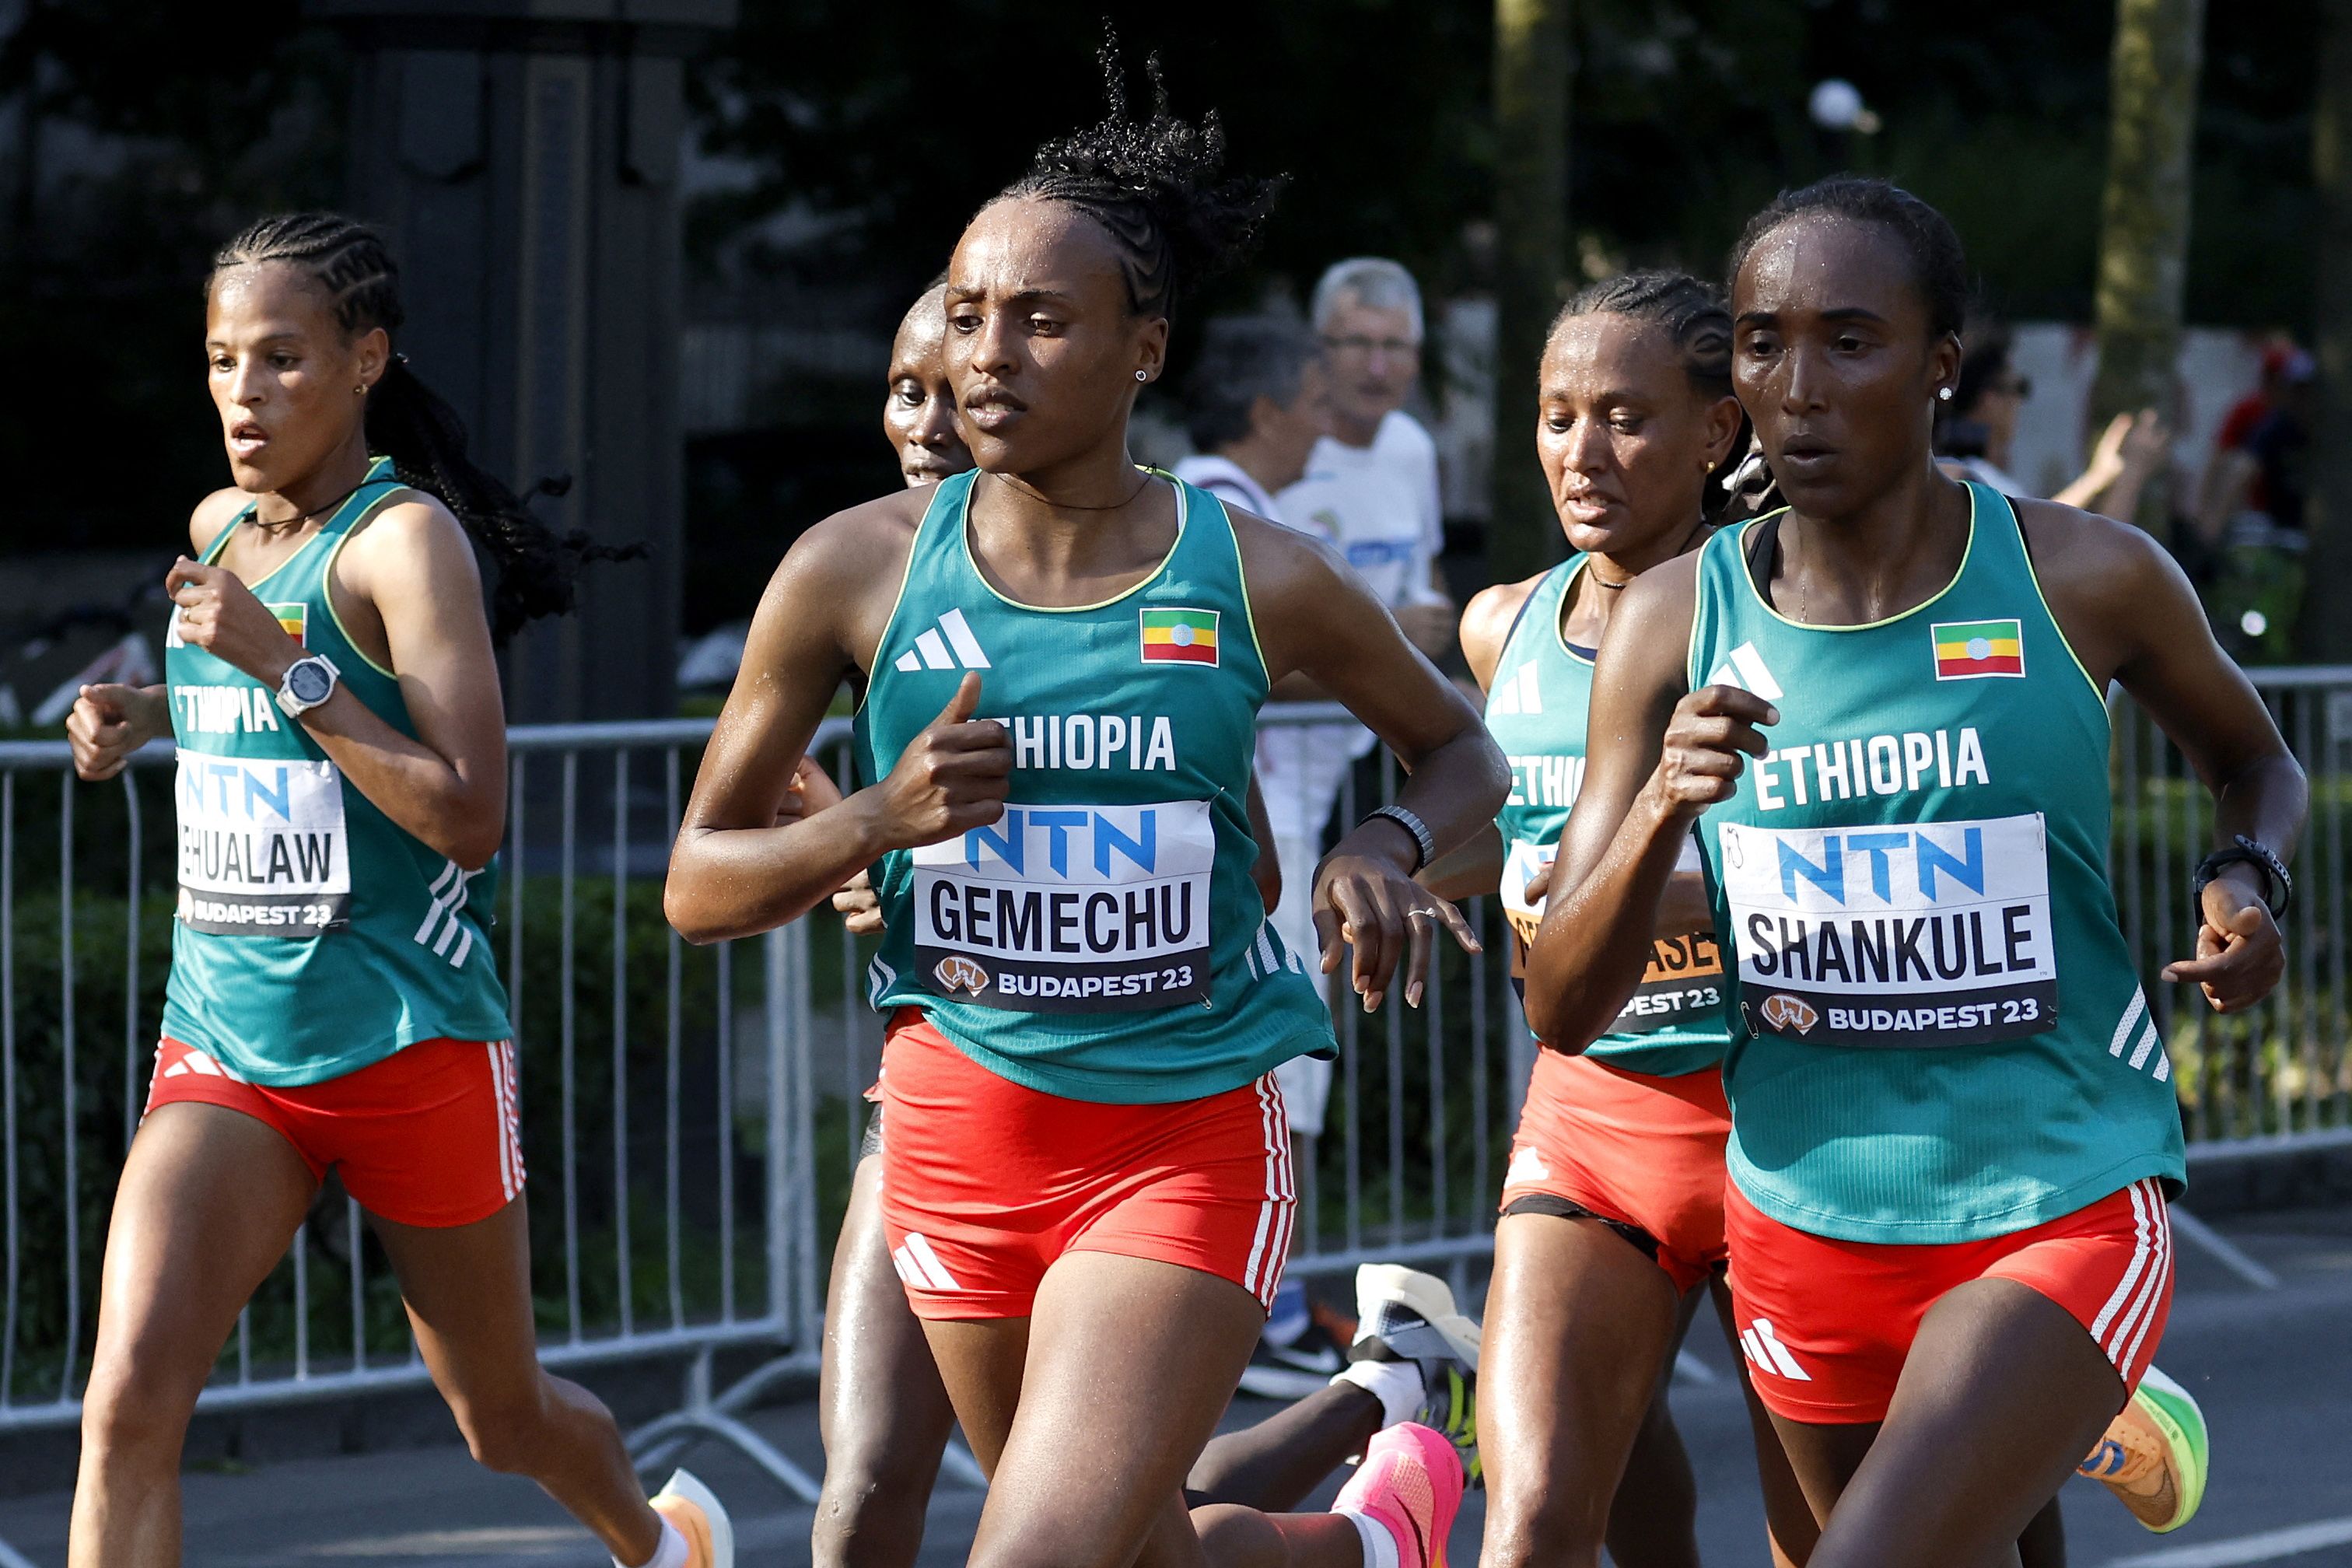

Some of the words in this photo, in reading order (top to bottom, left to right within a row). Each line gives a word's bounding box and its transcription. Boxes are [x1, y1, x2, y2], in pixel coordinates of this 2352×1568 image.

[967, 716, 1176, 771] HIOPIA
[1752, 727, 1990, 811] ETHIOPIA
[186, 761, 291, 823] NTN
[179, 823, 332, 884] EHUALAW
[965, 810, 1156, 880] NTN
[1776, 827, 1985, 906] NTN
[194, 901, 299, 925] BUDAPEST
[303, 905, 331, 926] 23
[930, 880, 1192, 954] GEMECHU
[1748, 904, 2037, 984] SHANKULE
[998, 970, 1158, 998] BUDAPEST
[1161, 964, 1193, 990] 23
[1618, 991, 1684, 1018] PEST
[1686, 987, 1720, 1009] 23
[1829, 1003, 1999, 1031] BUDAPEST
[2001, 998, 2039, 1023] 23
